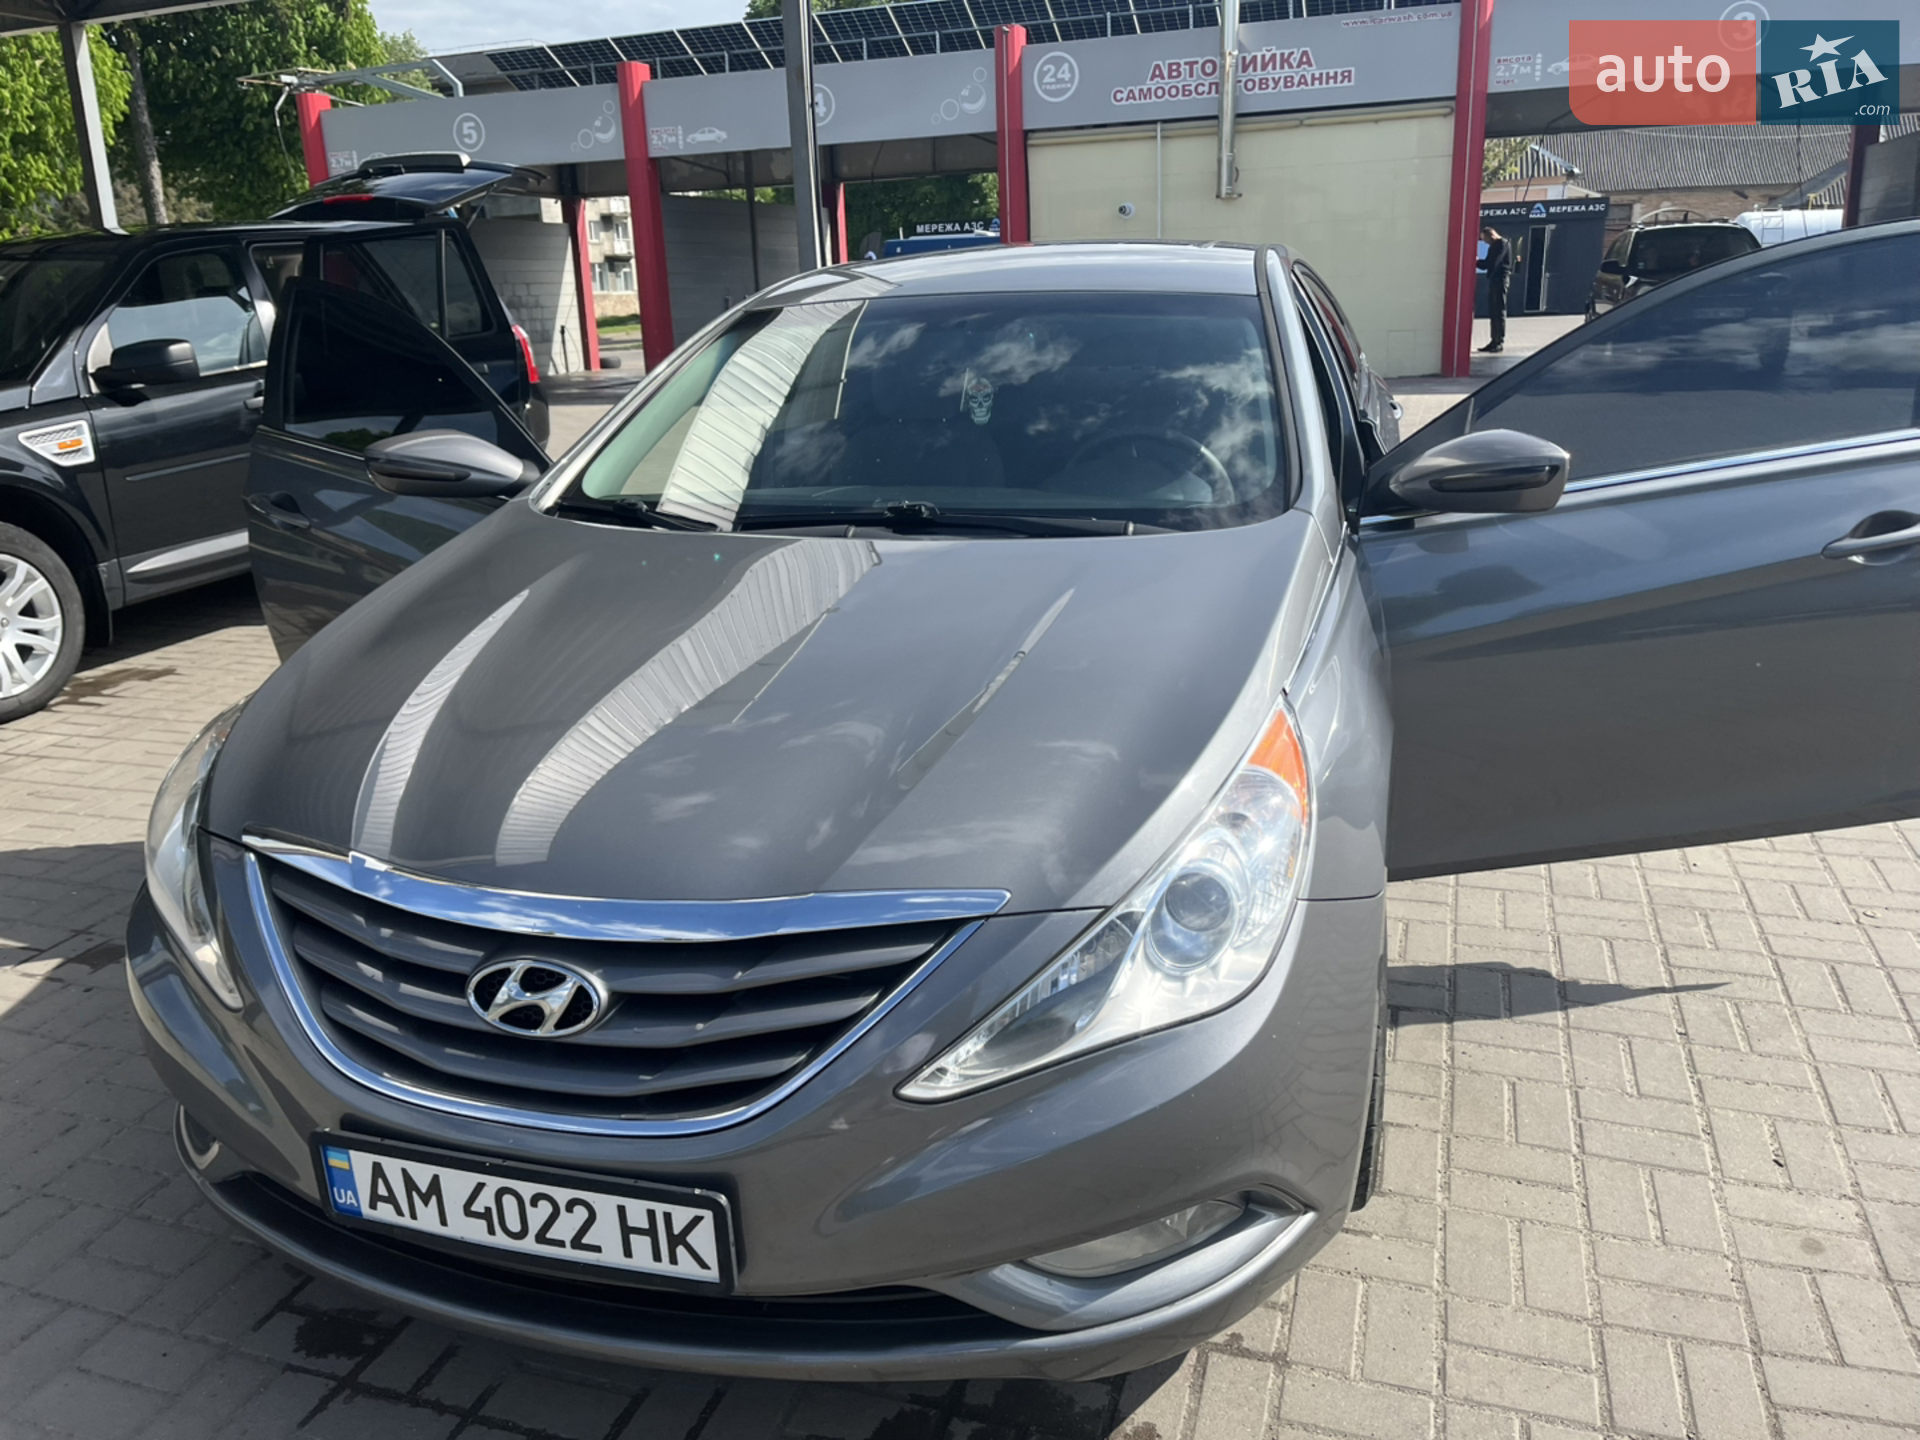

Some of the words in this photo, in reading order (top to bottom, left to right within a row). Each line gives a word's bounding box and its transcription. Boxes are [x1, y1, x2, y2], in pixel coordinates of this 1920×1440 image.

[1731, 11, 1757, 41] 3
[1042, 62, 1071, 83] 24
[1149, 48, 1314, 82] АВТОИЙКА
[1496, 64, 1531, 77] 2,7м
[1112, 69, 1353, 103] САМООБСЛОВУВАННЯ
[814, 92, 827, 117] 4
[463, 121, 477, 144] 5
[1479, 208, 1508, 217] ЕРЕЖА
[1549, 205, 1586, 213] МЕРЕЖА
[1588, 203, 1606, 212] АЗС
[916, 223, 960, 233] МЕРЕЖА
[333, 1186, 358, 1207] UA
[368, 1160, 448, 1227] AM
[463, 1181, 602, 1254] 4022
[616, 1204, 712, 1271] HK
